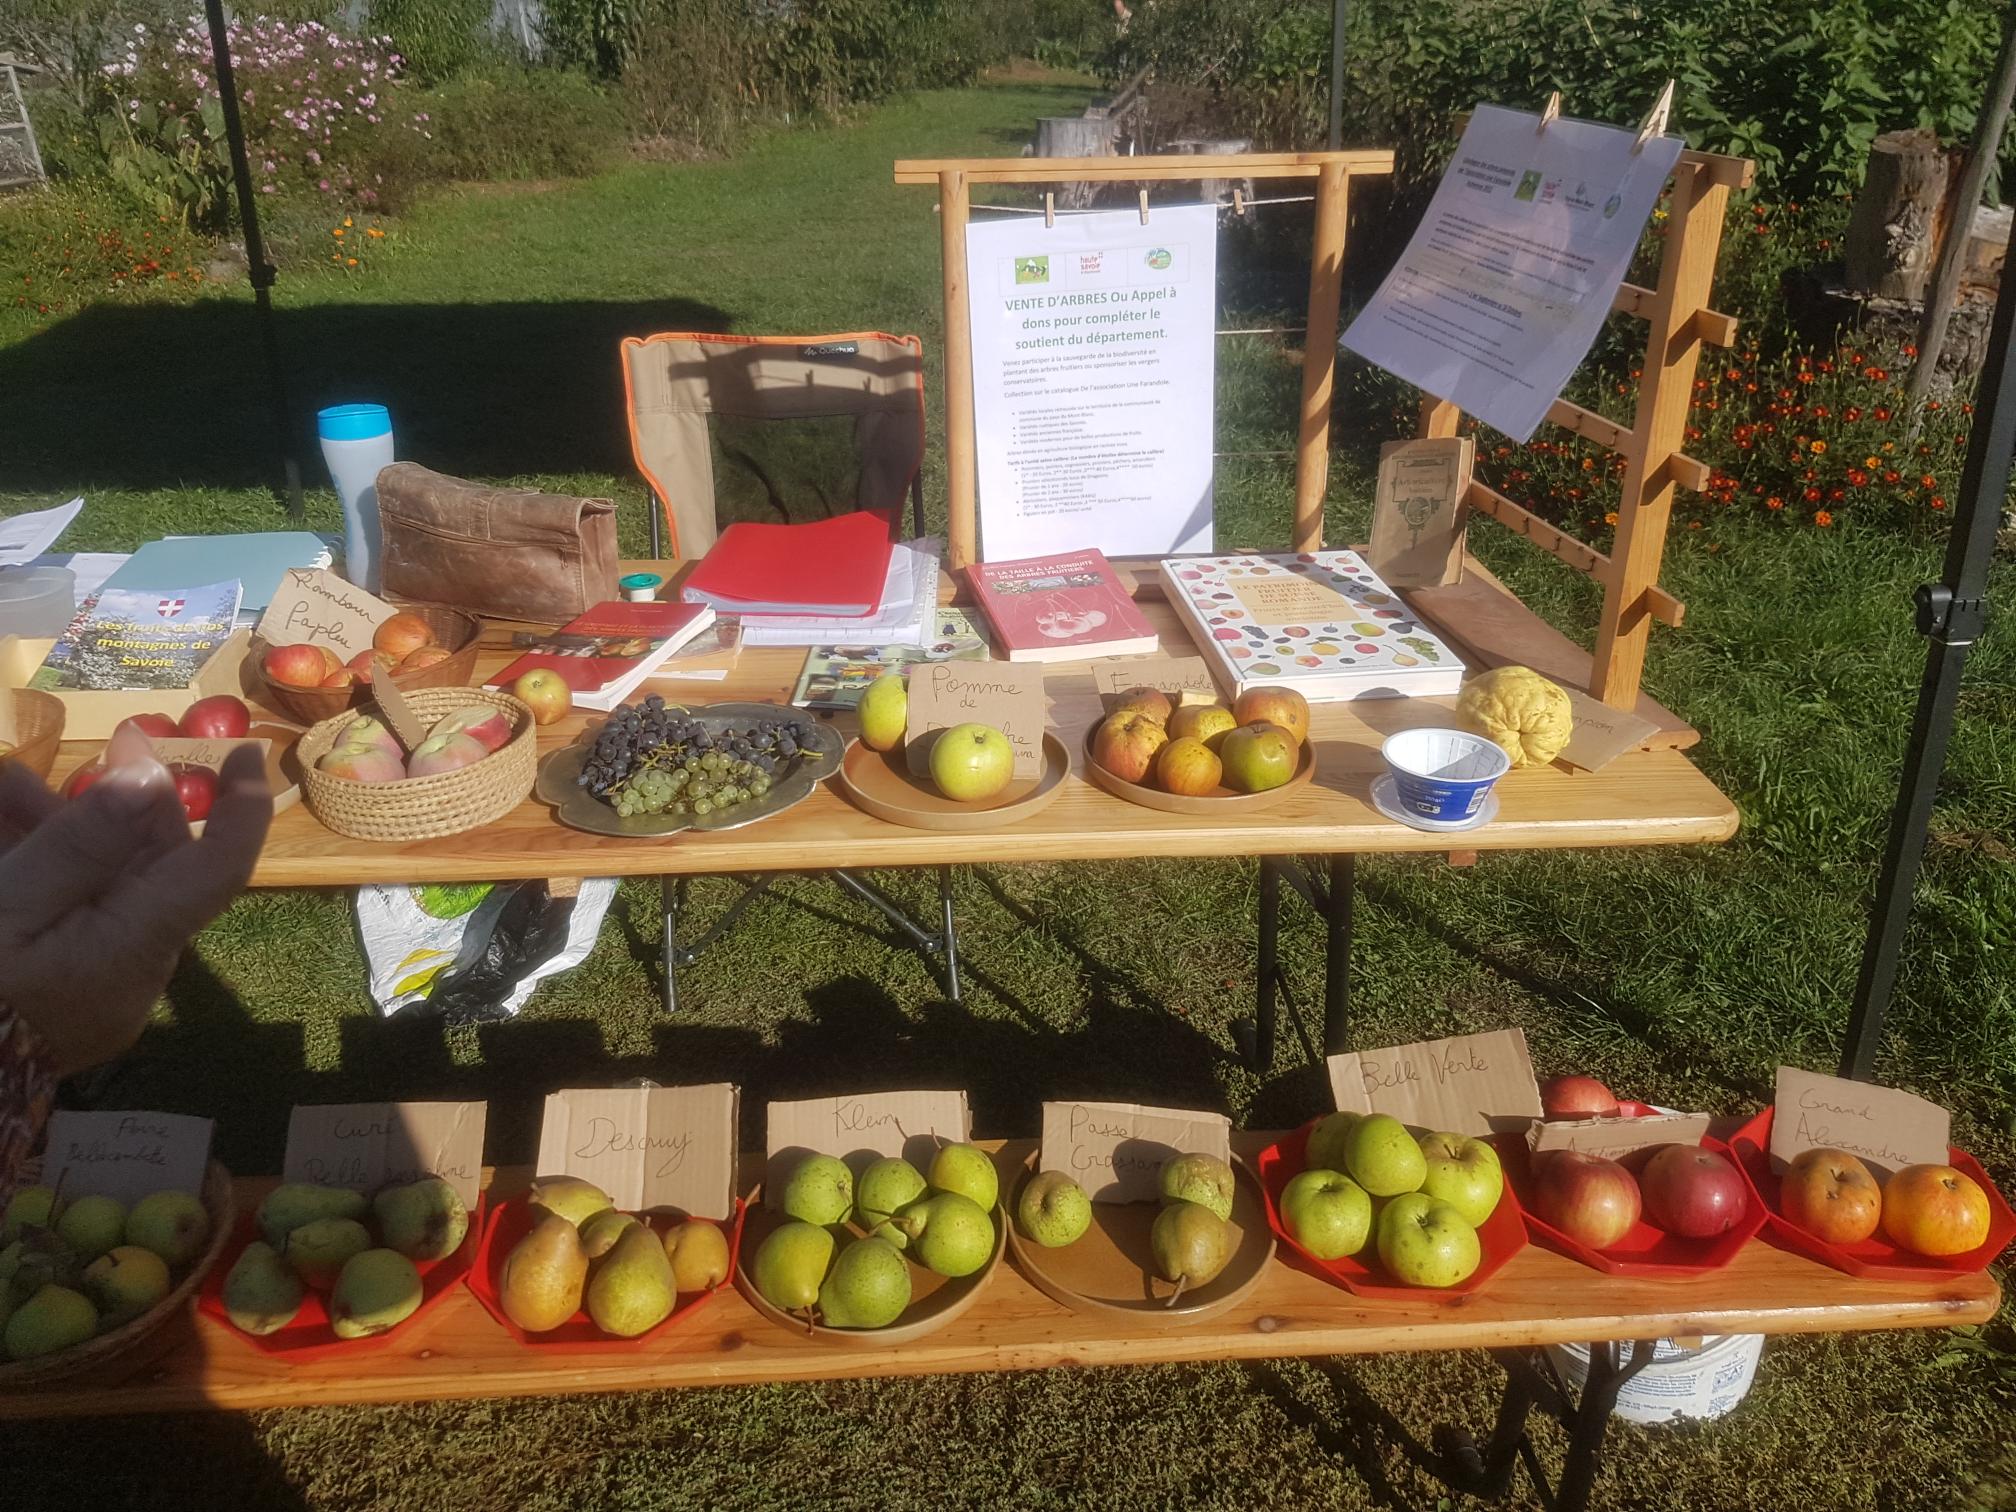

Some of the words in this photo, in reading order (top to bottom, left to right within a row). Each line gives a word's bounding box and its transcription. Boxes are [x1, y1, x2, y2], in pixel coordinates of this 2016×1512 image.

[1005, 297, 1044, 311] VENTE
[1110, 291, 1128, 303] Ou
[1131, 287, 1166, 303] Appel
[1169, 286, 1177, 298] à
[1022, 318, 1051, 330] dons
[1054, 316, 1082, 331] pour
[1085, 309, 1147, 327] compléter
[1150, 308, 1161, 320] le
[1015, 334, 1065, 350] soutient
[1067, 333, 1083, 345] du
[1086, 328, 1168, 347] département.
[1009, 567, 1033, 575] TAILLE
[1056, 559, 1094, 570] CONDUITE
[1047, 567, 1085, 576] FRUITIERS
[96, 620, 124, 632] Les
[173, 622, 193, 633] de
[96, 638, 187, 651] montagnes
[191, 640, 212, 650] de
[120, 655, 175, 668] Savoie
[932, 665, 1023, 702] Pomme
[959, 697, 978, 709] de
[1360, 1060, 1421, 1095] Belle
[1431, 1043, 1489, 1085] Verte
[1799, 1087, 1874, 1121] Grand
[1070, 1104, 1139, 1142] Passe
[1795, 1111, 1914, 1165] Alexandre
